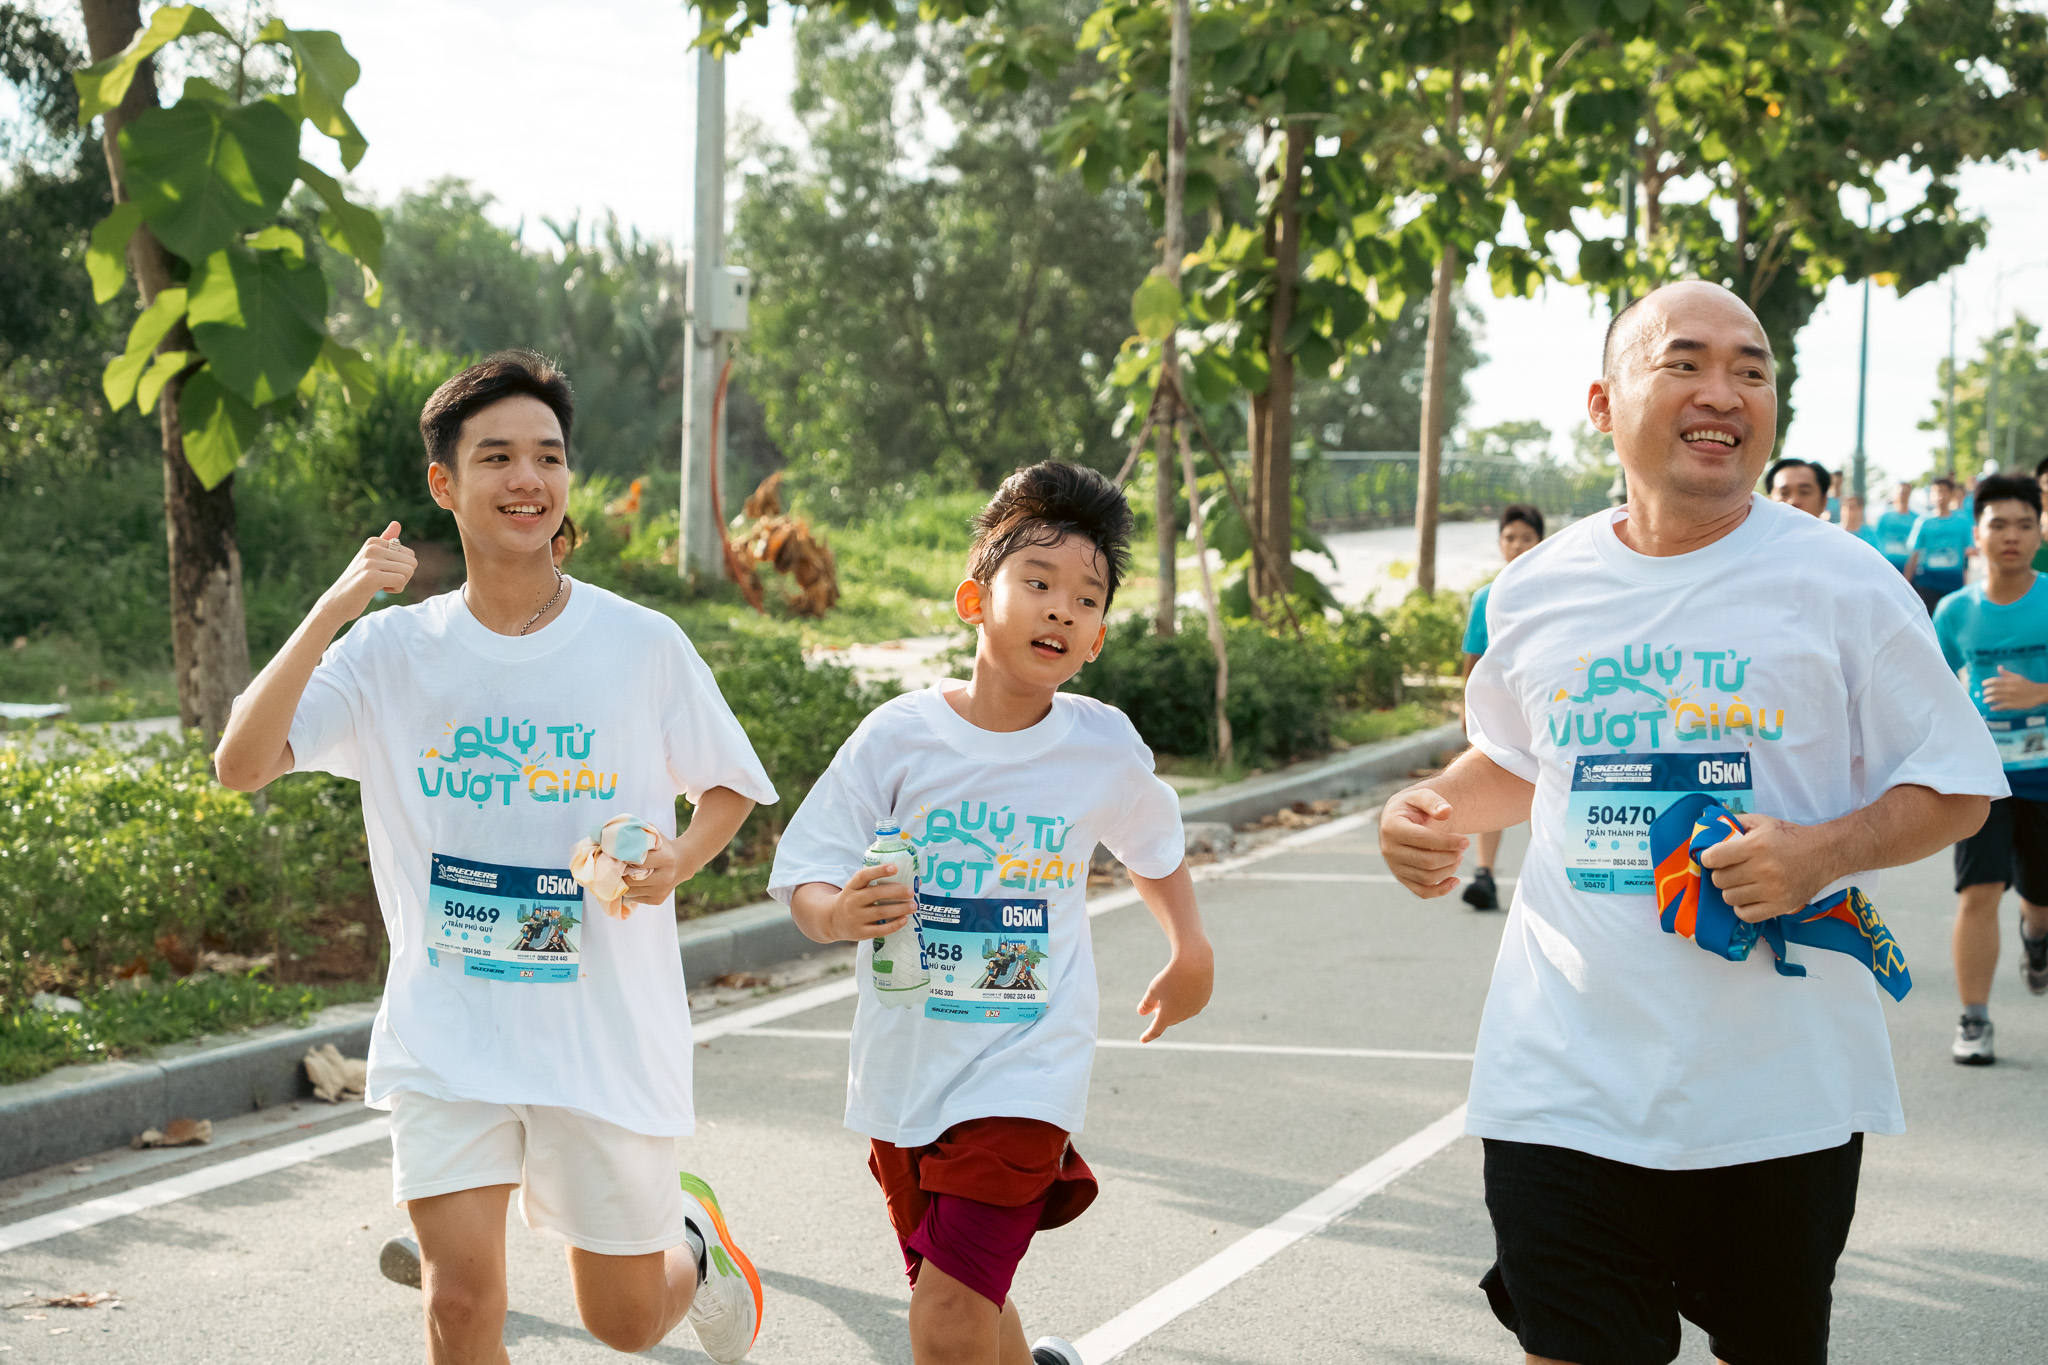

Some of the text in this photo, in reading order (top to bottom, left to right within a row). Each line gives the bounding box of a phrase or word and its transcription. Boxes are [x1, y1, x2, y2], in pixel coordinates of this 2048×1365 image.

[1591, 760, 1746, 785] SKECHERS 05KM
[417, 767, 520, 810] VƯỢT
[1587, 805, 1657, 826] 50470
[446, 865, 578, 896] SKECHERS 05KM
[919, 852, 994, 898] ƯỢT
[1583, 881, 1606, 889] 50470
[443, 899, 501, 924] 50469
[919, 902, 1043, 927] ECHERS 05KM
[926, 942, 963, 961] 458
[470, 965, 506, 975] SKECHERS
[928, 961, 939, 970] HÚ
[930, 1006, 970, 1015] SKECHERS
